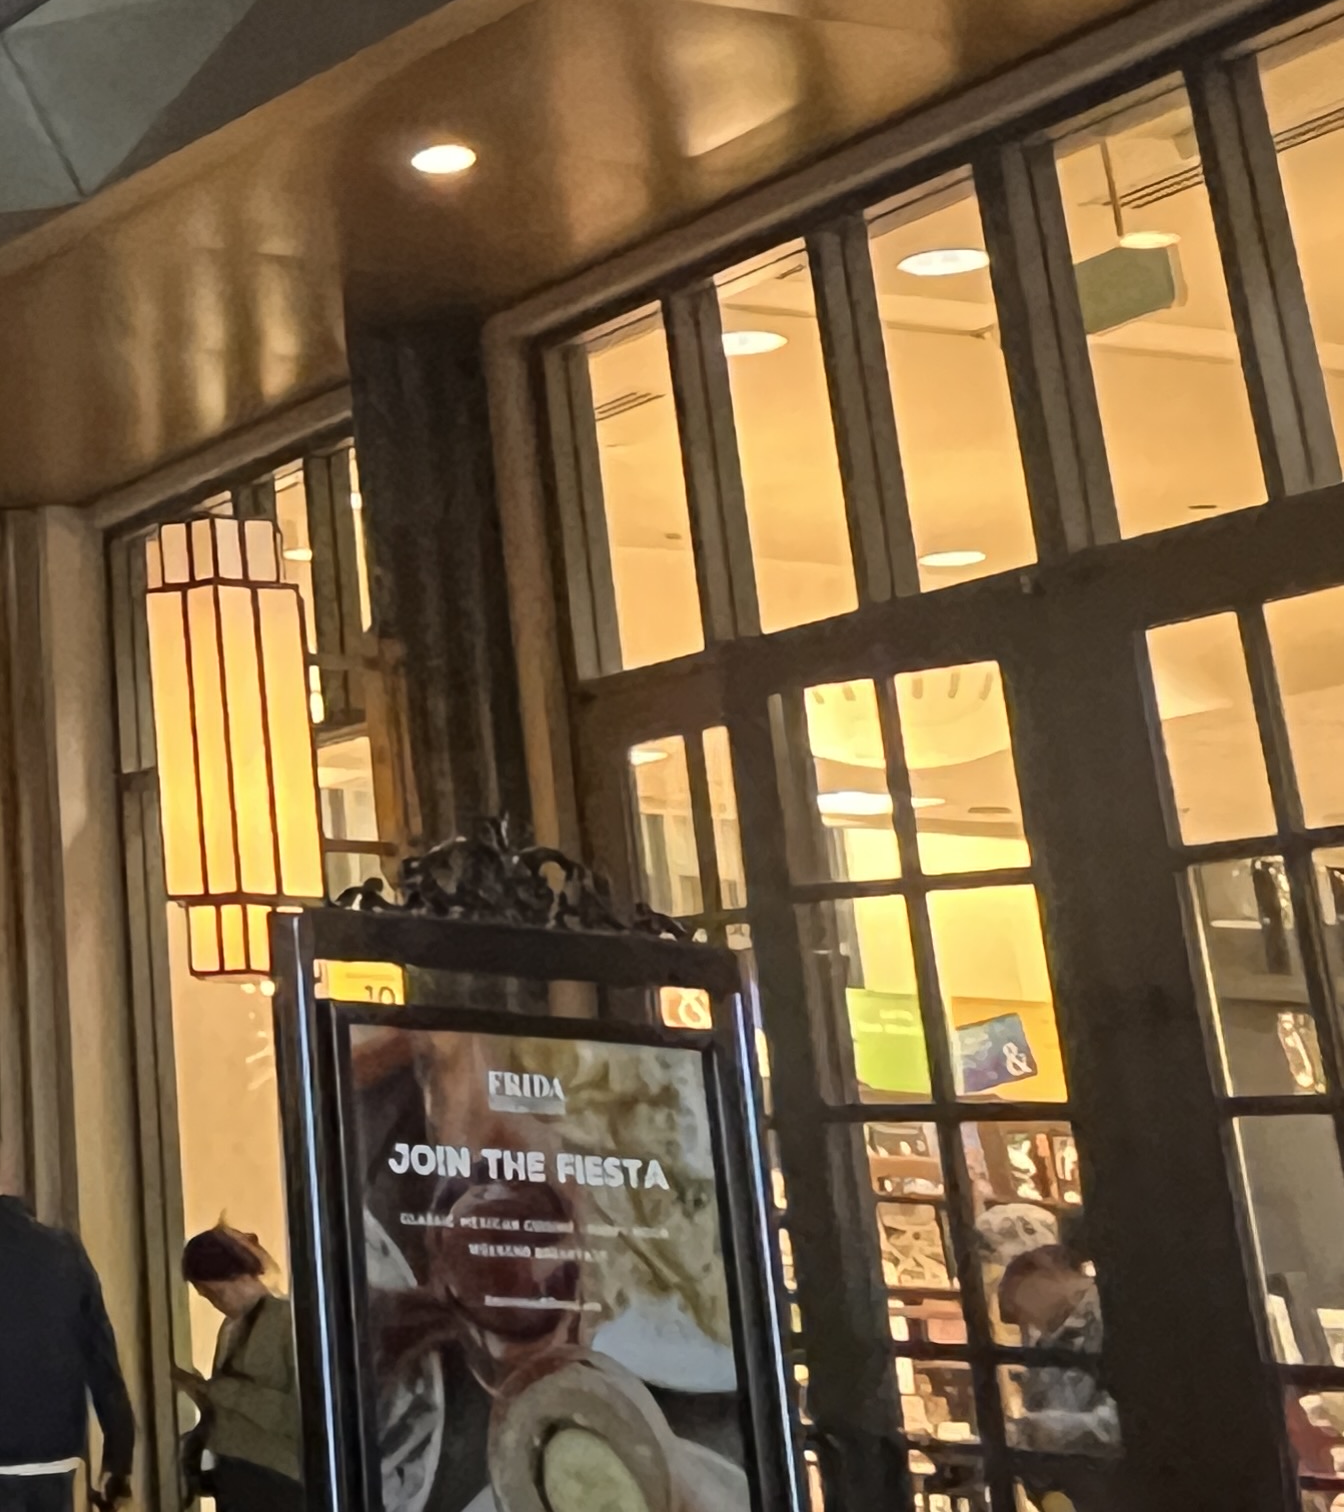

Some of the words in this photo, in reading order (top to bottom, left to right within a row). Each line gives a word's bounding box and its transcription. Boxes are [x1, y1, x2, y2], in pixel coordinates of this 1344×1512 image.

[487, 1070, 566, 1100] FRIDA
[387, 1143, 472, 1179] JOIN
[480, 1148, 547, 1183] THE
[555, 1152, 671, 1191] FIESTA
